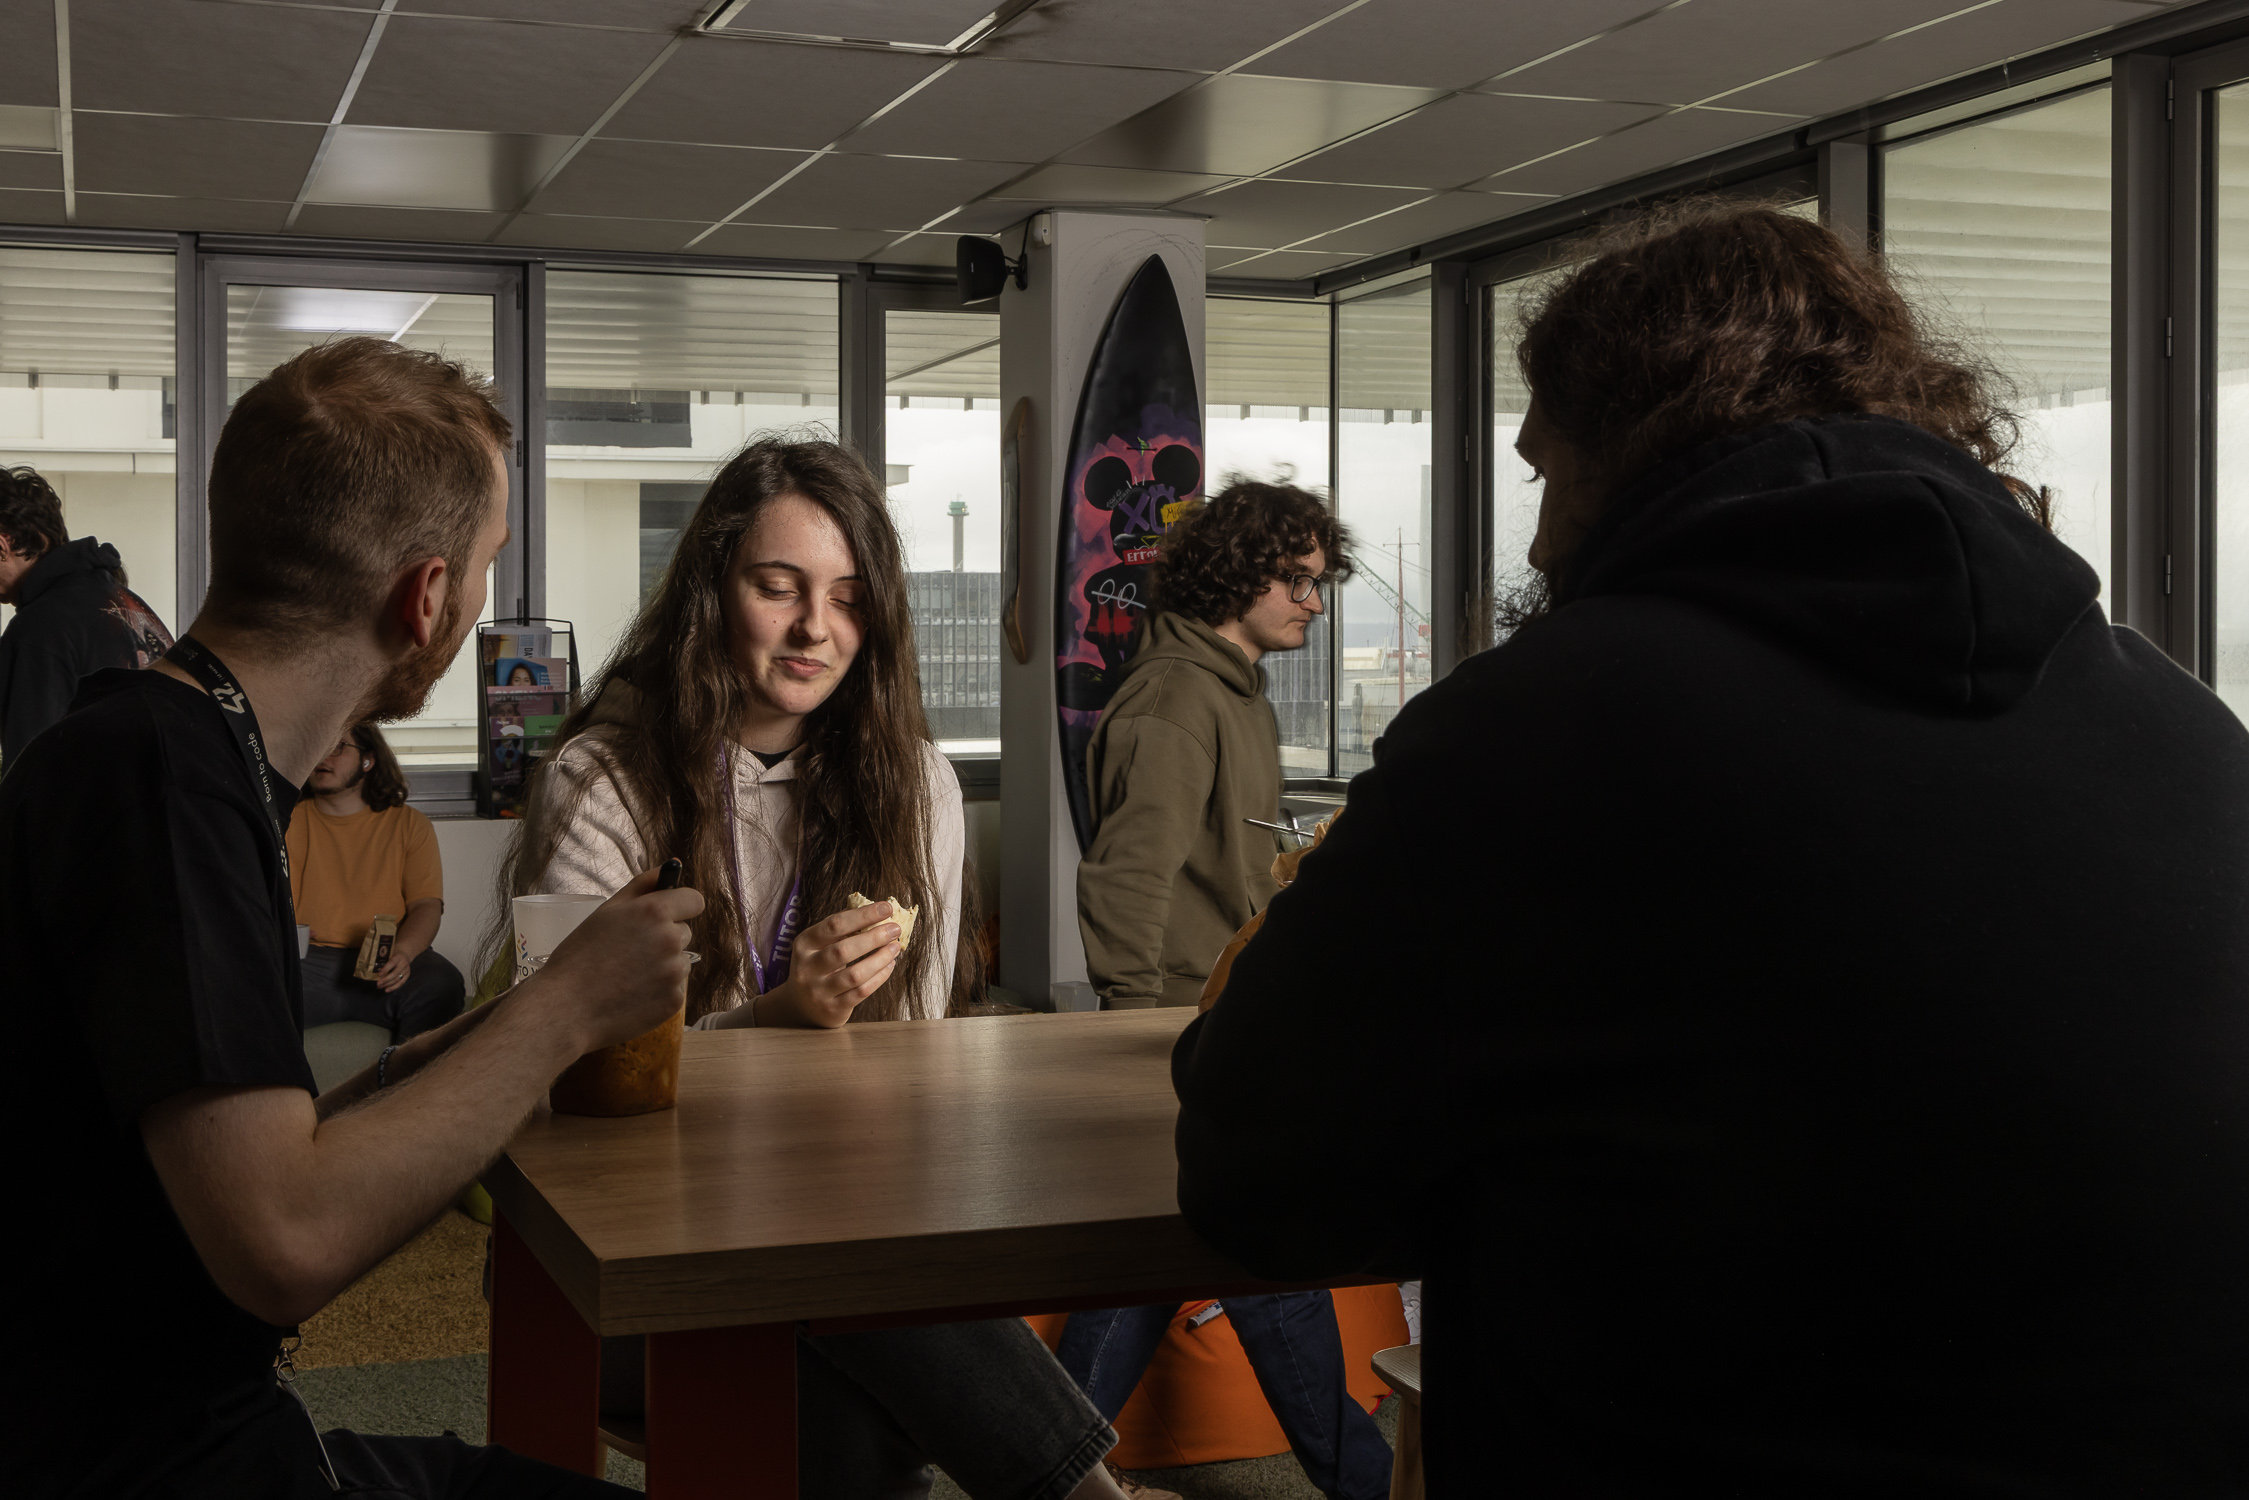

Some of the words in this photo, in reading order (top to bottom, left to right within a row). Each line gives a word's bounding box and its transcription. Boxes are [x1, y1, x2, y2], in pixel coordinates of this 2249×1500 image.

[524, 647, 533, 658] DA
[212, 682, 245, 714] 42
[248, 732, 262, 762] code
[260, 775, 272, 803] Born
